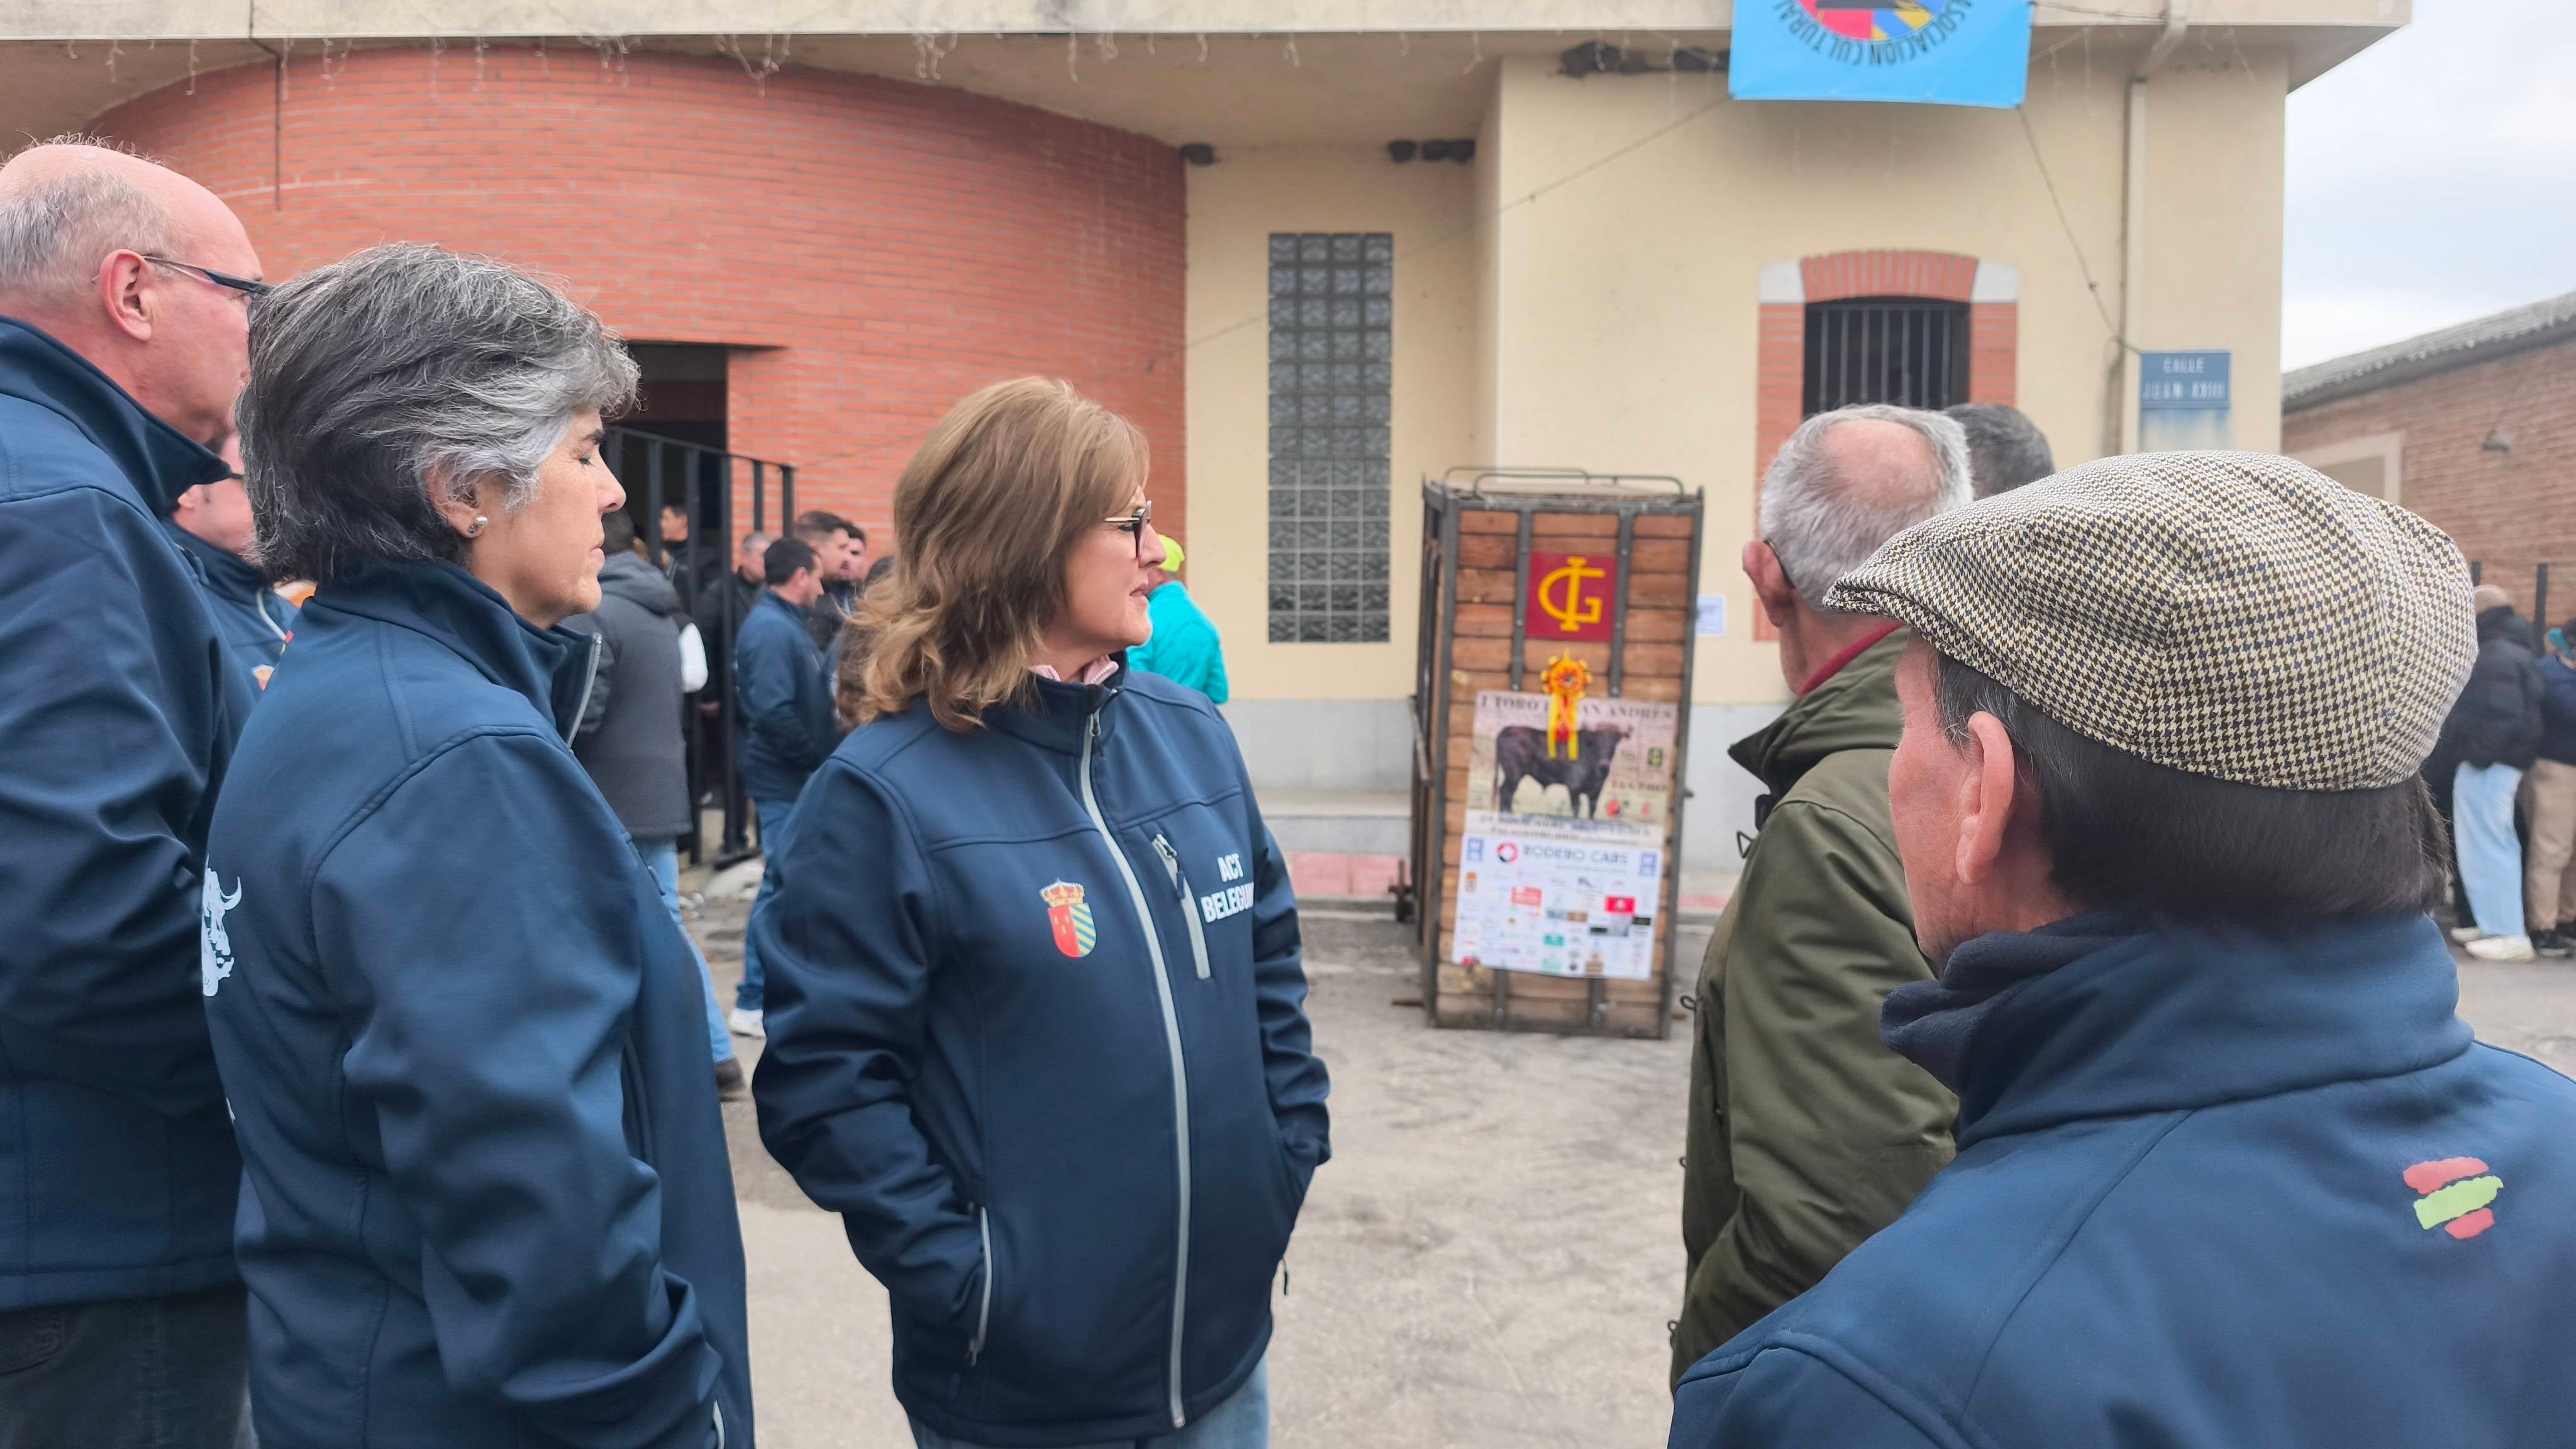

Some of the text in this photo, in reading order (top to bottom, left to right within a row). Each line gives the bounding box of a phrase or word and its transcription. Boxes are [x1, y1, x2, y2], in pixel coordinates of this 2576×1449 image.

[2163, 357, 2204, 374] CALLE
[2143, 381, 2184, 400] JUAN
[1494, 696, 1539, 710] TORO
[1522, 843, 1585, 862] RODERO
[1590, 851, 1629, 864] CARS
[1217, 853, 1244, 882] ACT
